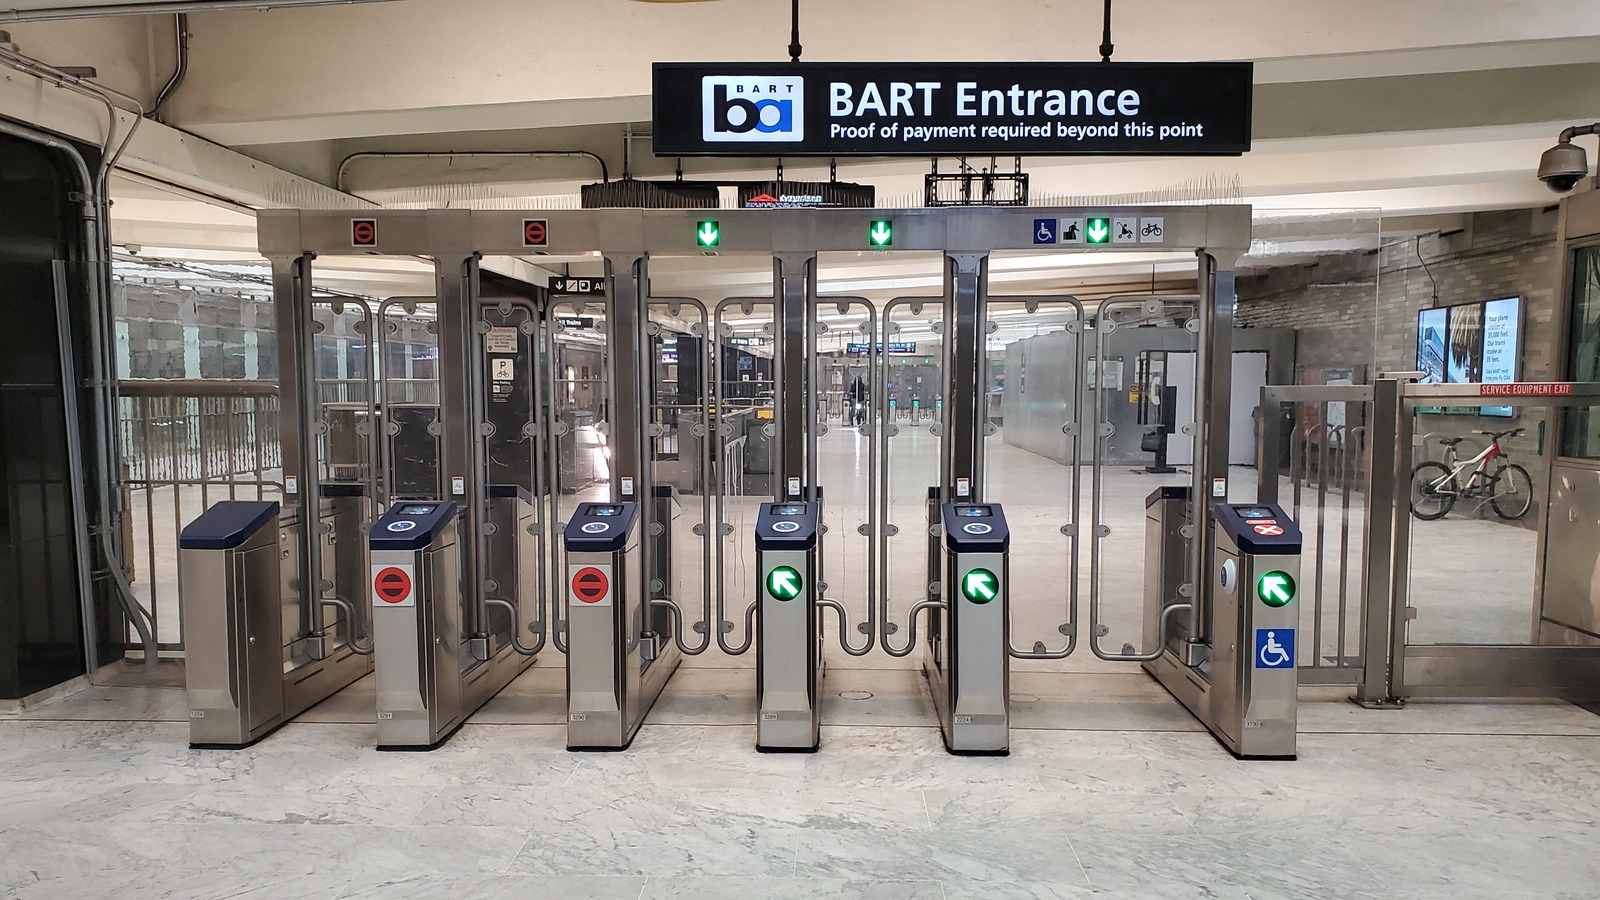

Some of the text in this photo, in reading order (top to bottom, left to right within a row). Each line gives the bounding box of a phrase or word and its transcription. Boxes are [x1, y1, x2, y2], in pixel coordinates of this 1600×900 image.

[736, 84, 794, 94] BART
[829, 82, 1141, 117] BART Entrance
[830, 122, 1204, 142] Proof of payment required beyond this point
[500, 361, 506, 370] P
[1481, 384, 1570, 394] SERVICE EQUIPMENT EXIT
